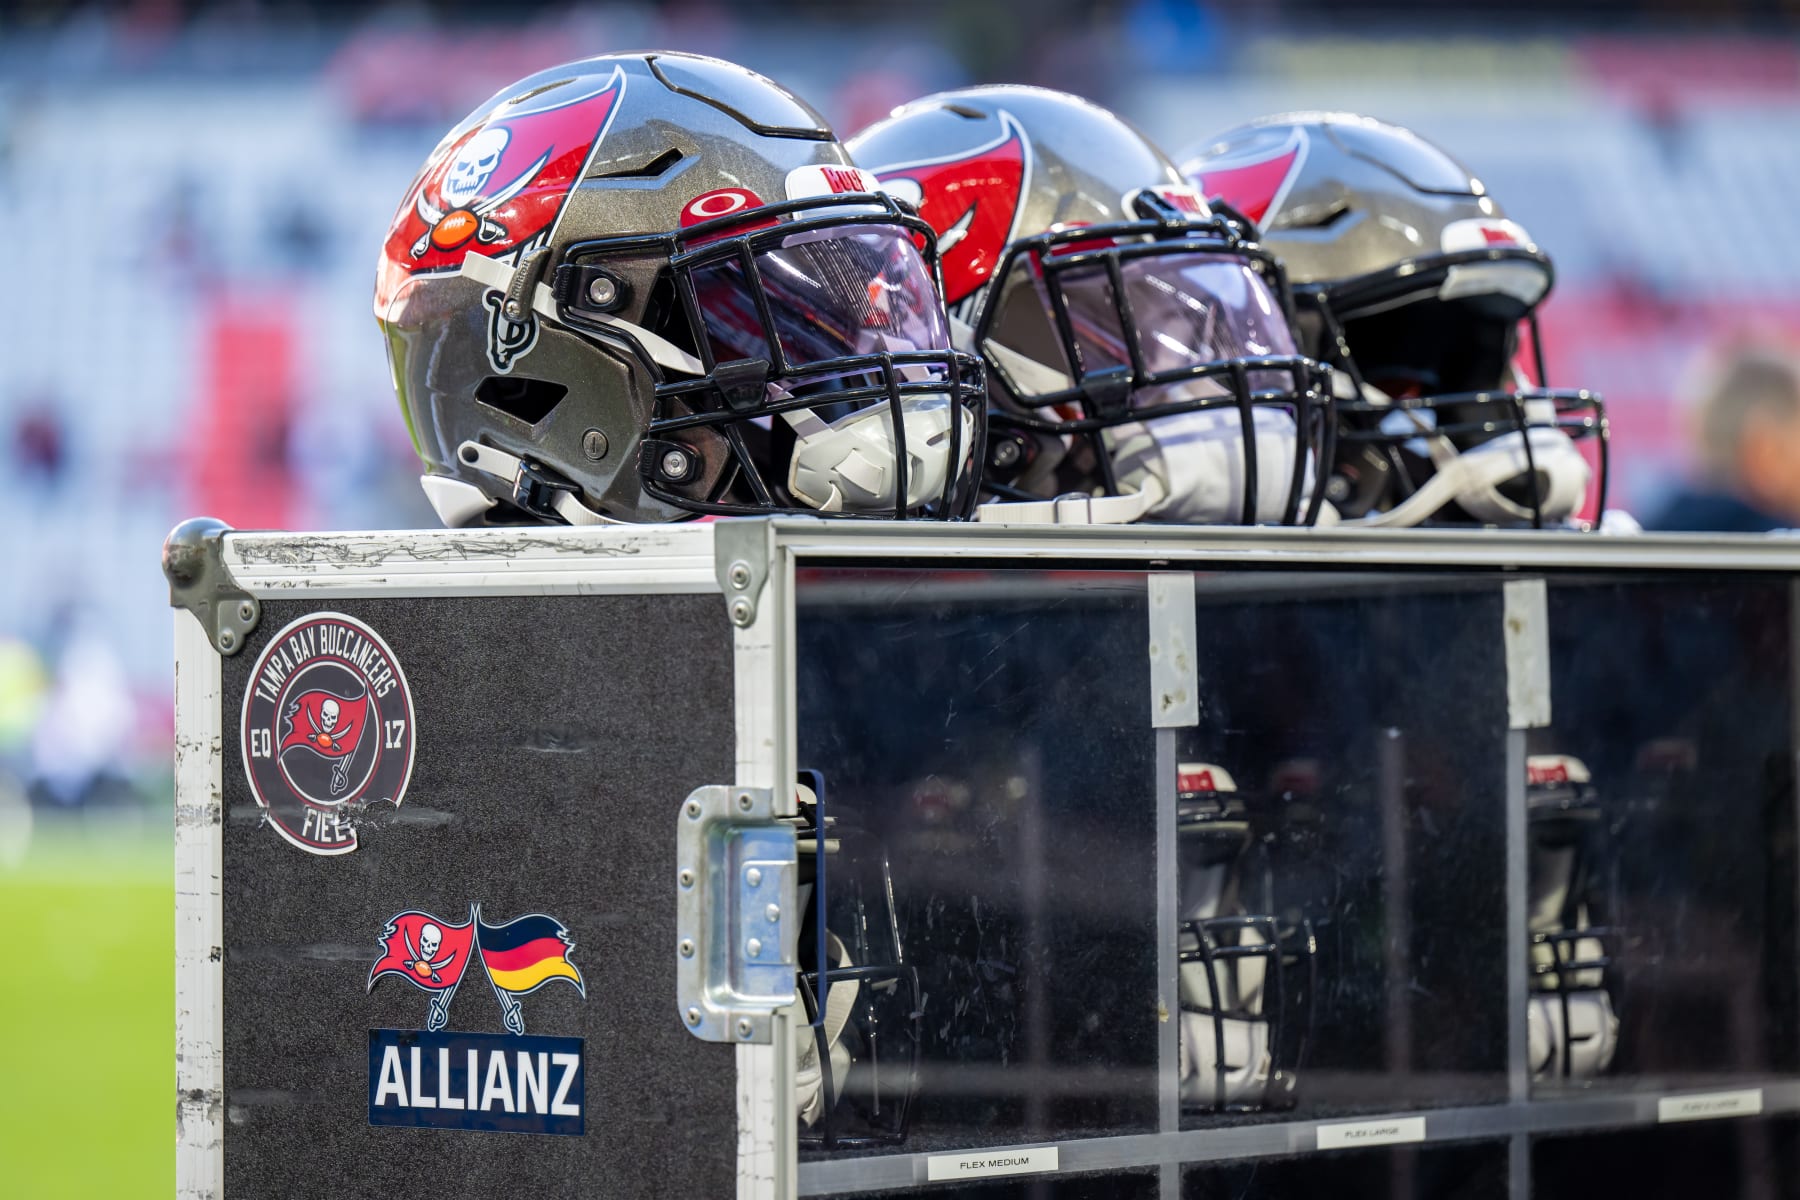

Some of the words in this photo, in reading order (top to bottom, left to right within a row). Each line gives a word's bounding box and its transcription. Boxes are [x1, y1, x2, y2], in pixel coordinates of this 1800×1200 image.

[255, 658, 296, 704] TAMPA
[289, 627, 318, 667] BAY
[320, 625, 397, 698] BUCCANEERS
[251, 728, 271, 759] EQ
[384, 720, 406, 749] 17
[374, 1045, 581, 1117] ALLIANZ
[960, 1161, 985, 1170] FLEX
[988, 1157, 1029, 1168] MEDIUM
